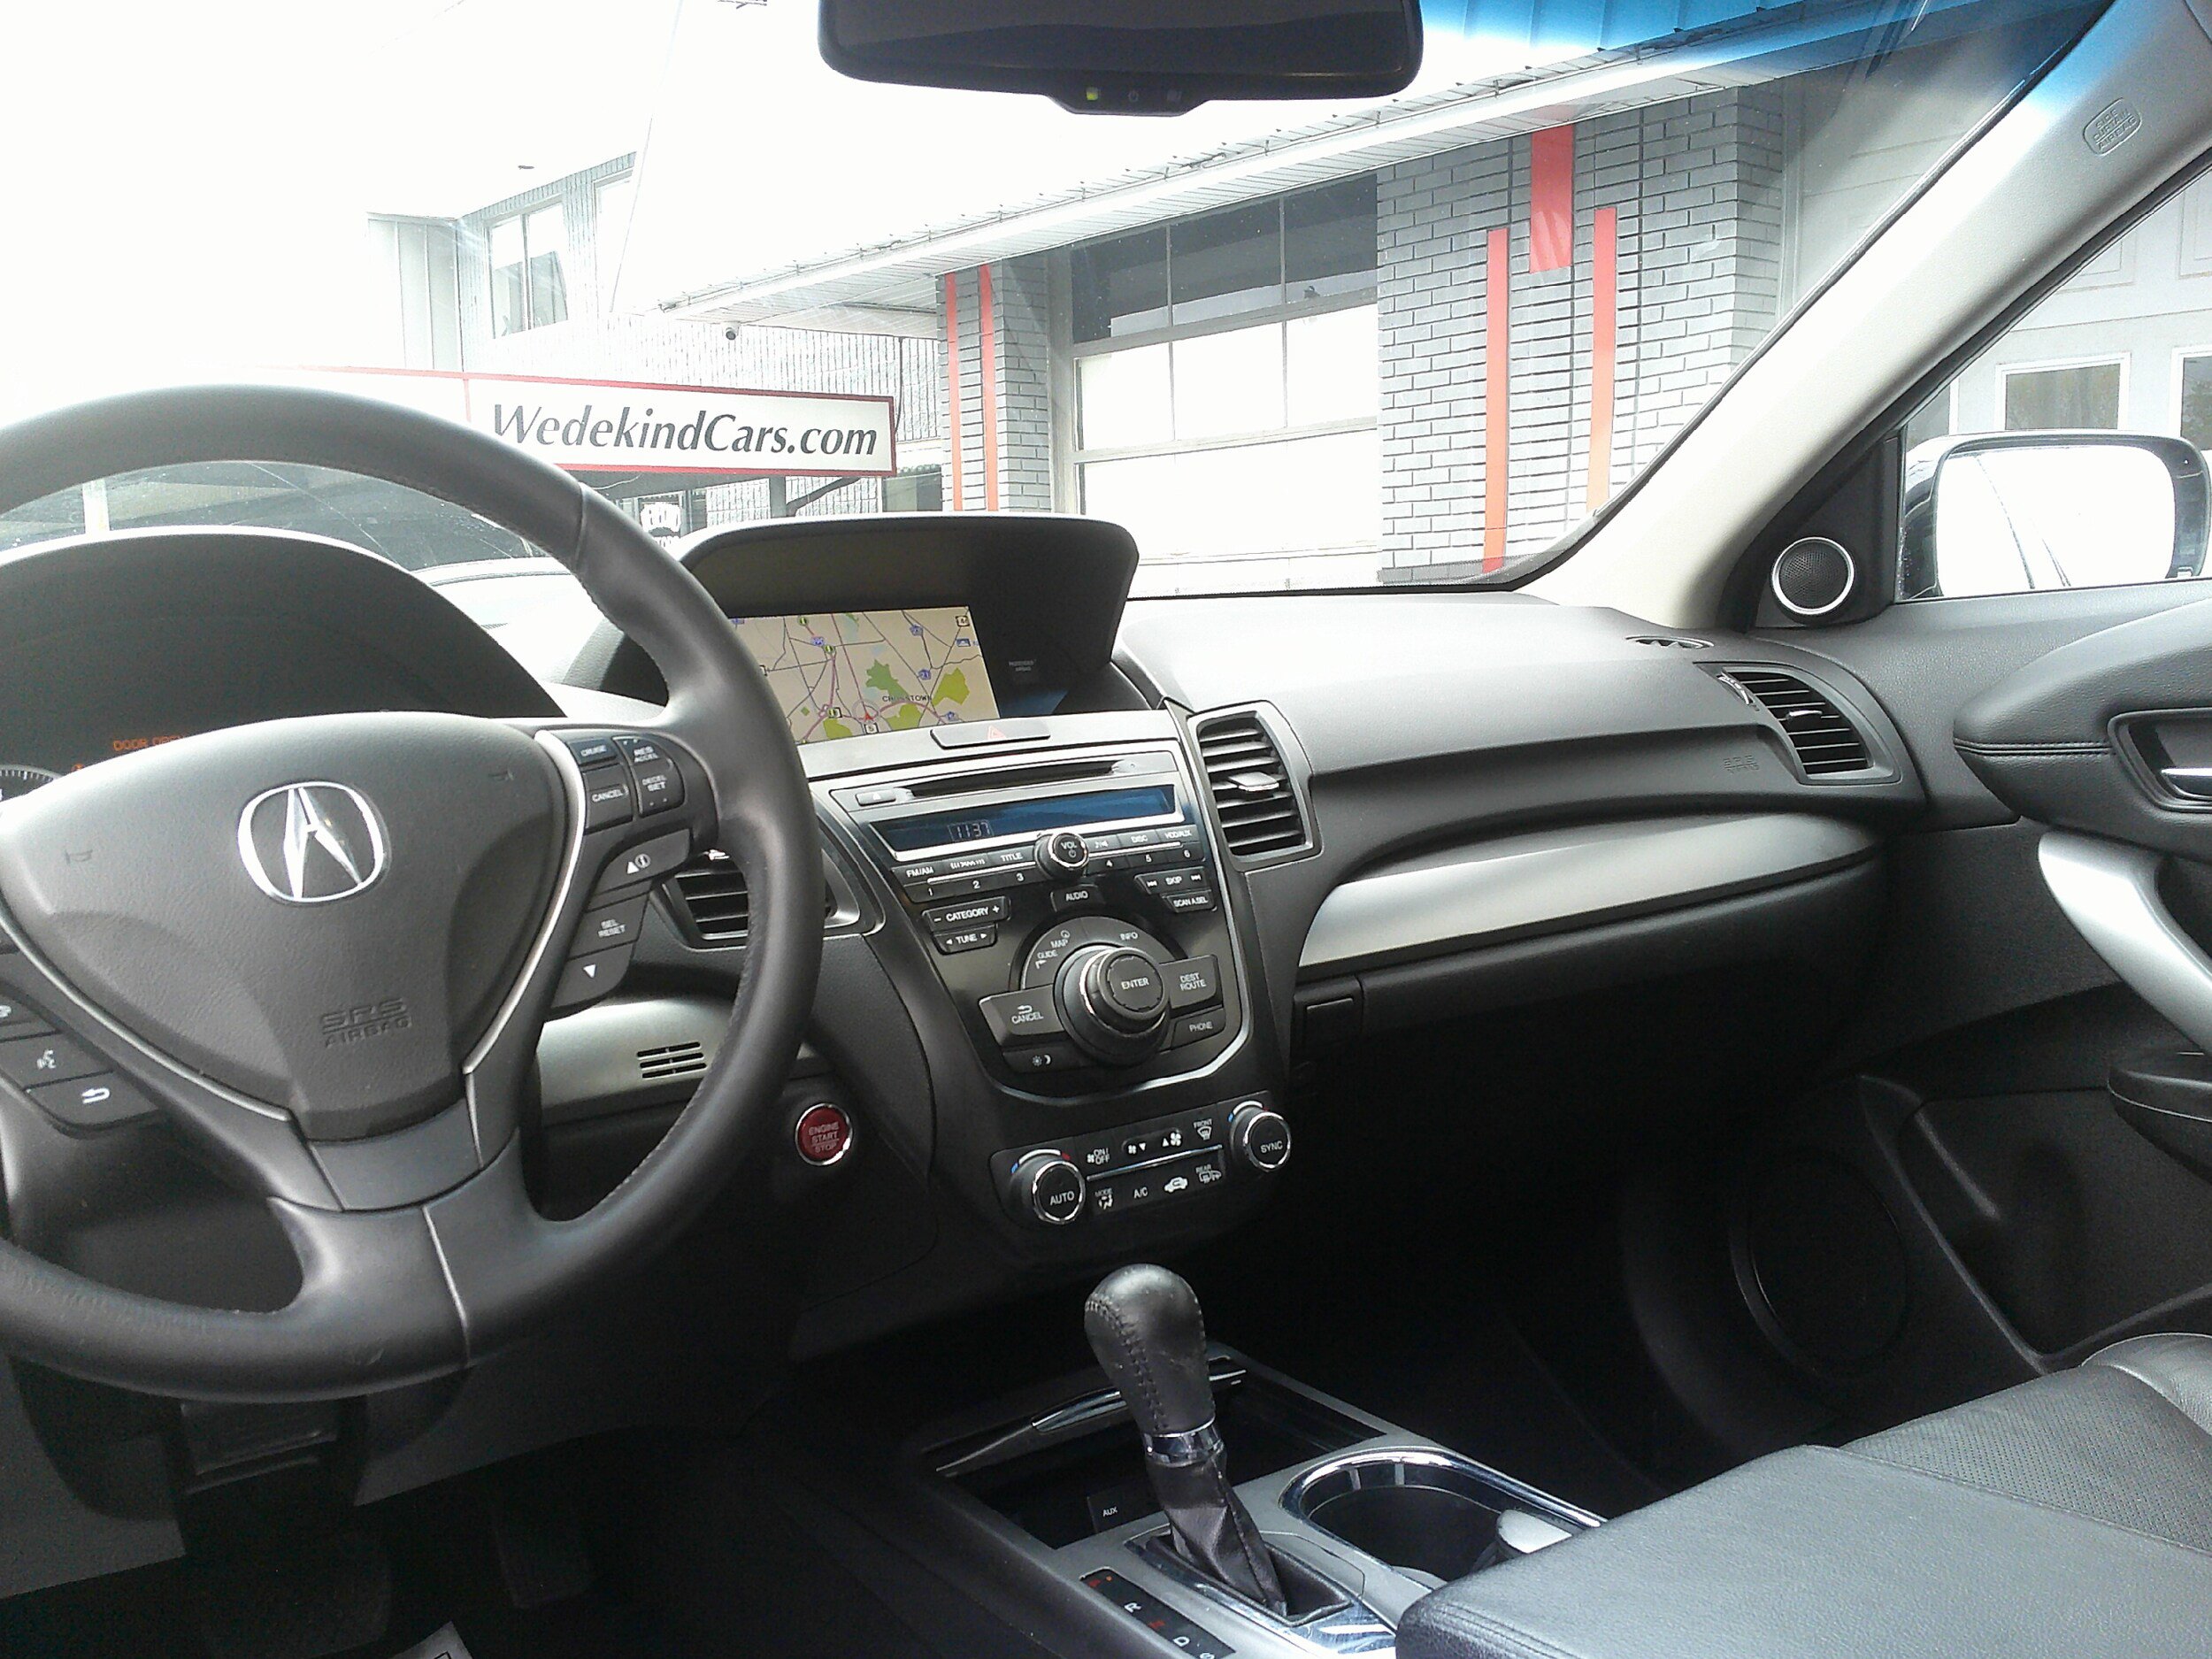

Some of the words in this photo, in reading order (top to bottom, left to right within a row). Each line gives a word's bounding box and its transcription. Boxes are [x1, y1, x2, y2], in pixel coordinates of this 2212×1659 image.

[495, 404, 877, 455] WedekindCars.com
[113, 738, 148, 751] DOOR
[592, 788, 625, 803] CANCEL
[1061, 841, 1077, 850] VOL
[906, 865, 934, 878] FM/AM
[1001, 852, 1023, 862] TITLE
[1131, 834, 1148, 843] DISC
[972, 880, 980, 889] 2
[1145, 854, 1152, 863] 5
[1184, 849, 1190, 858] 6
[1165, 876, 1182, 886] SKIP
[1065, 891, 1088, 902] AUDIO
[946, 907, 988, 922] CATEGORY
[956, 933, 977, 944] TUNE
[1119, 932, 1139, 941] INFO
[1050, 939, 1069, 949] MAP
[1037, 949, 1058, 960] GUIDE
[1179, 972, 1200, 982] DEST
[1121, 978, 1150, 990] ENTER
[1179, 979, 1207, 992] ROUTE
[1011, 1012, 1044, 1025] CANCEL
[1189, 1021, 1212, 1033] PHONE
[1194, 1119, 1212, 1130] FRONT
[811, 1131, 838, 1143] START
[815, 1142, 837, 1153] STOP
[1260, 1141, 1284, 1154] SYNC
[1095, 1155, 1110, 1164] OFF
[1195, 1164, 1211, 1173] REAR
[1094, 1187, 1113, 1197] MODE
[1133, 1187, 1148, 1199] A/C
[1049, 1191, 1075, 1206] AUTO
[1102, 1506, 1118, 1517] AUX
[1124, 1601, 1141, 1613] R
[1172, 1636, 1190, 1647] D
